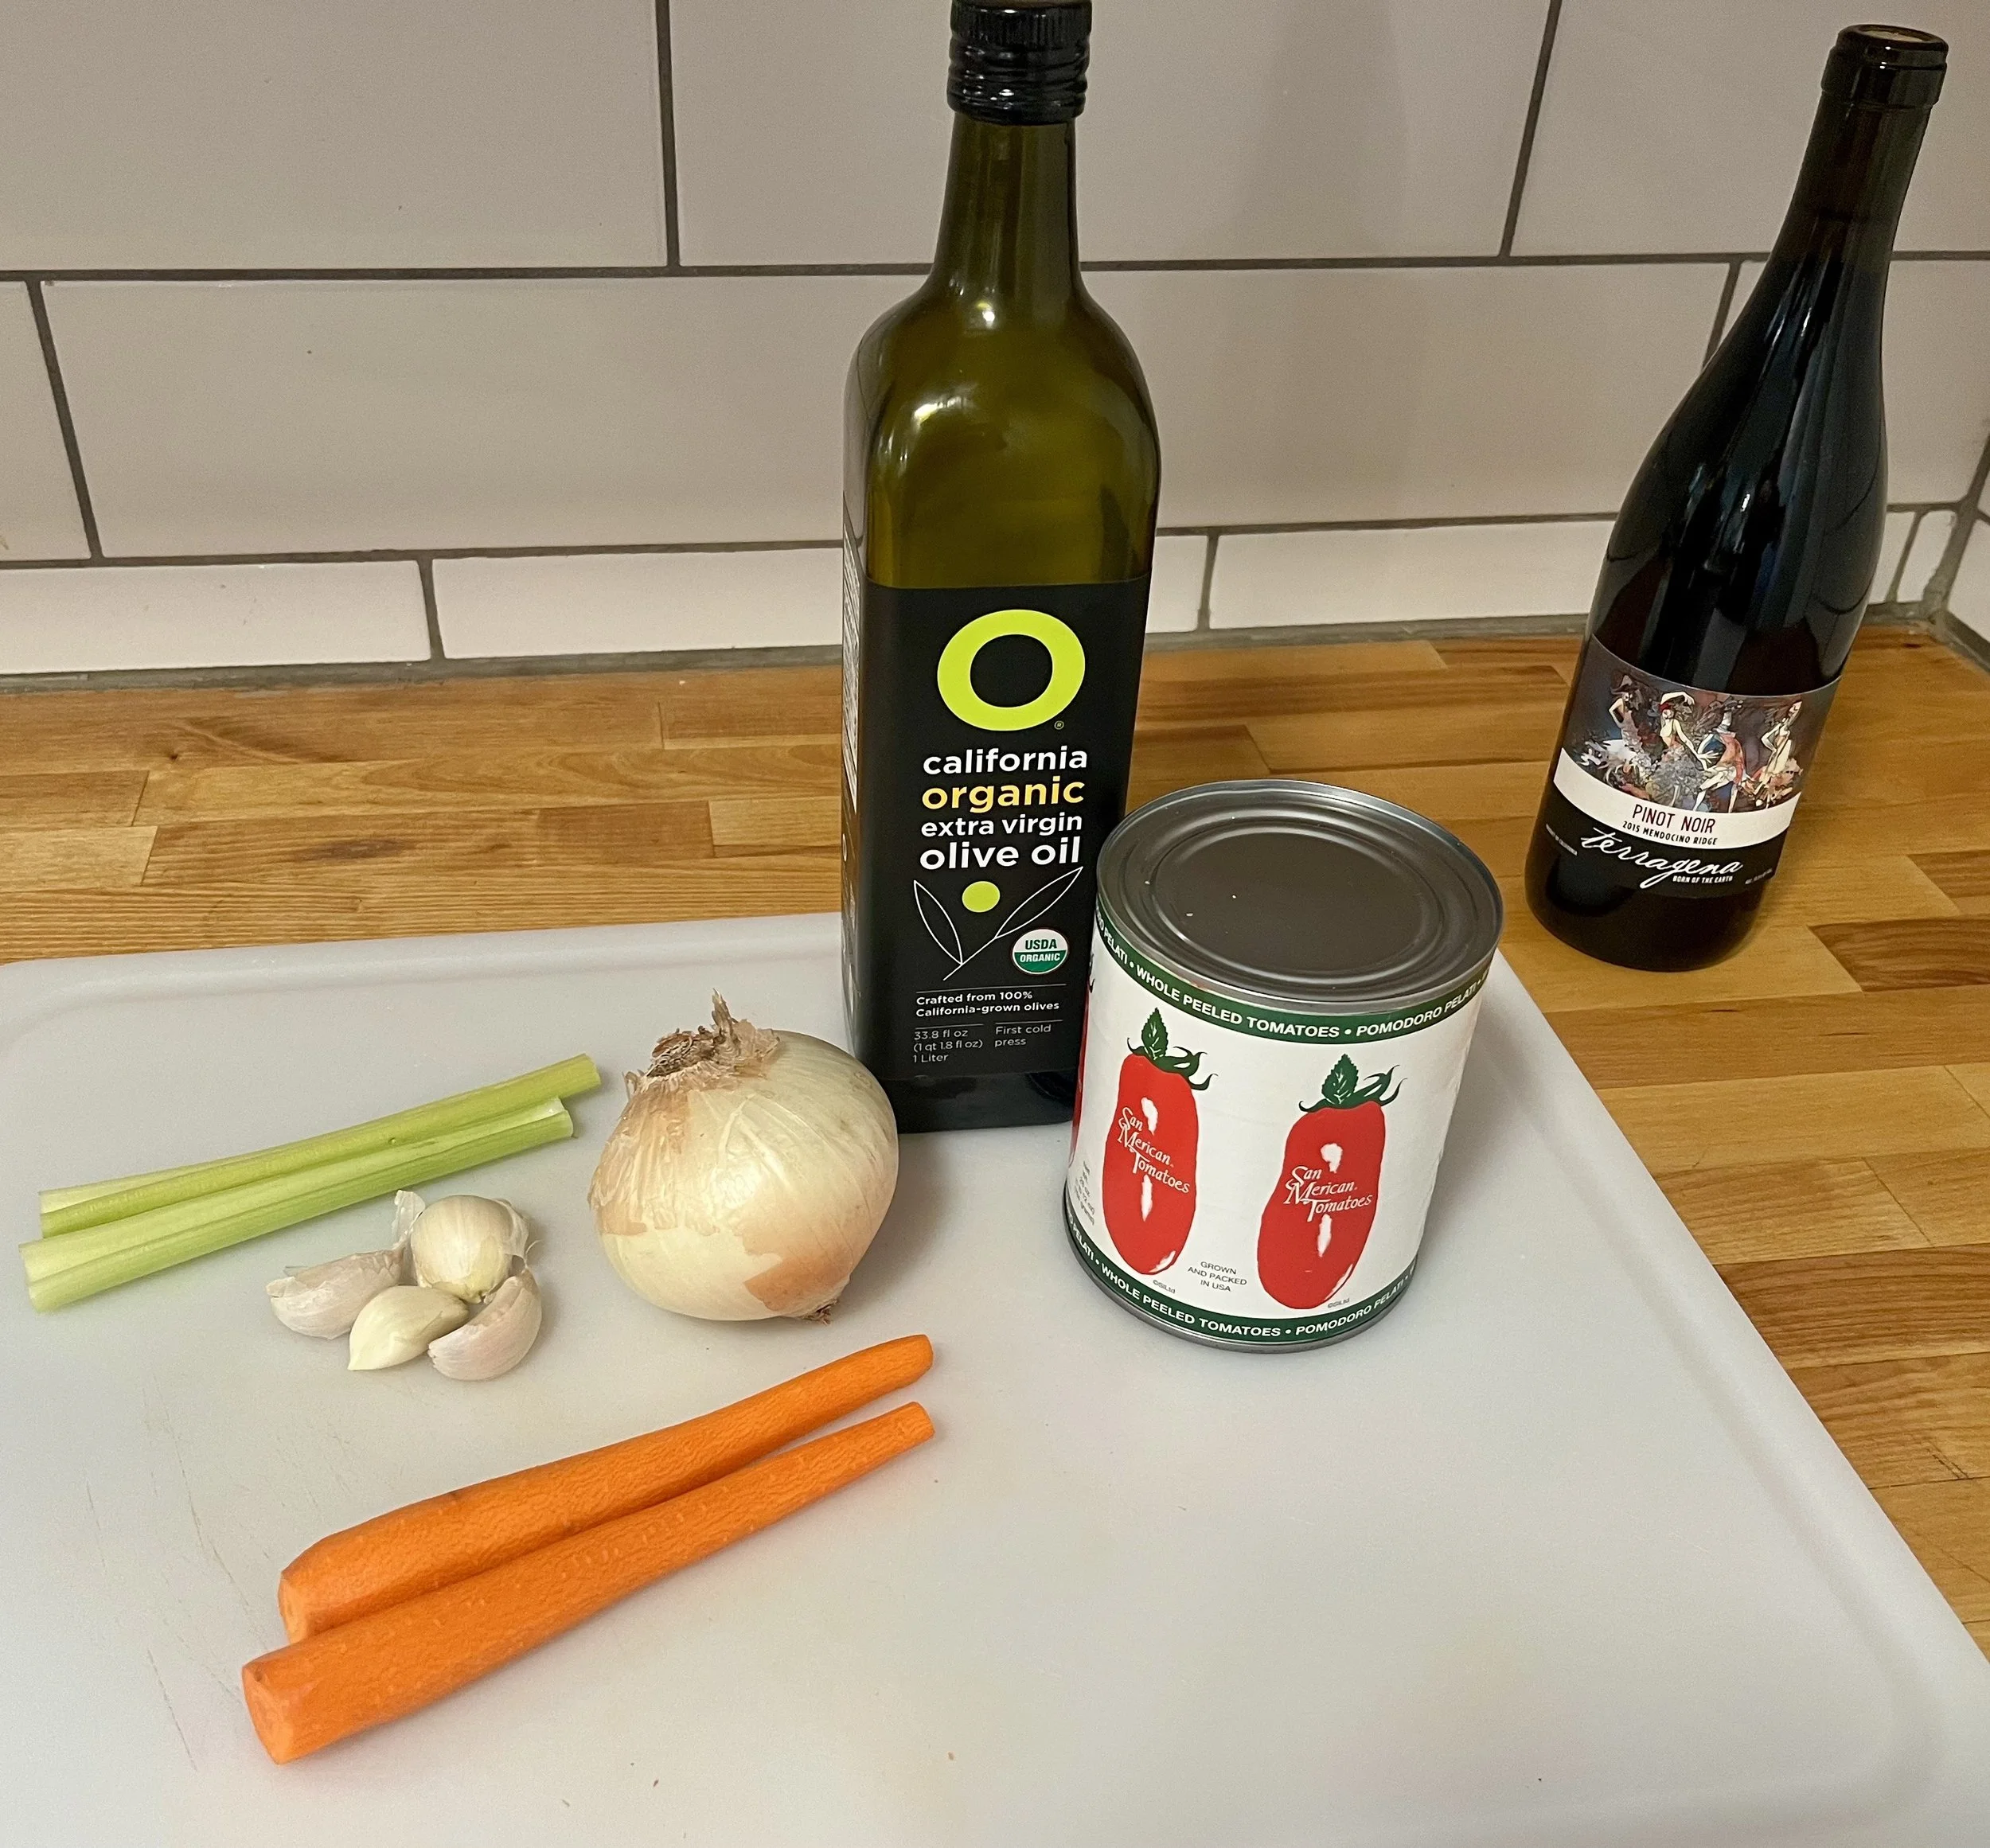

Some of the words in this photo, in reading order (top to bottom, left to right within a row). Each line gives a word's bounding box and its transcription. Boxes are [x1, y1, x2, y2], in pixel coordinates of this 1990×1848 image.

[923, 745, 1087, 775] california
[922, 776, 1085, 813] organic
[921, 818, 994, 837] extra
[1002, 812, 1083, 836] virgin
[1632, 804, 1676, 828] PINOT
[1681, 817, 1716, 834] NOIR
[1622, 821, 1641, 834] 2015
[1642, 827, 1692, 844] MENDOCINO
[1692, 836, 1719, 846] RIDGE
[919, 842, 1020, 870] olive
[1031, 836, 1081, 866] oil
[1024, 939, 1057, 950] USDA
[1020, 953, 1060, 963] ORGANIC
[1103, 926, 1129, 965] PELATI
[1136, 964, 1180, 1002] WHOLE
[1182, 995, 1243, 1026] PEELED
[1246, 1016, 1340, 1039] TOMATOES
[1356, 1007, 1442, 1038] POMODORO
[1444, 981, 1477, 1013] PELATI
[916, 993, 963, 1005] Crafted
[966, 992, 996, 1002] from
[1000, 991, 1032, 1000] 100%
[915, 1003, 1020, 1017] California-grown
[1024, 1002, 1059, 1012] olives
[914, 1030, 939, 1040] 33.8
[942, 1029, 952, 1038] fl
[954, 1029, 969, 1038] oz
[995, 1026, 1021, 1035] First
[1026, 1024, 1052, 1034] cold
[913, 1042, 923, 1053] (1
[924, 1041, 938, 1051] qt
[955, 1039, 964, 1050] fl
[966, 1039, 983, 1050] oz)
[995, 1037, 1026, 1048] press
[913, 1055, 918, 1064] 1
[921, 1053, 949, 1063] Liter
[1118, 1106, 1144, 1131] San
[1129, 1146, 1190, 1195] Tomatoes
[1286, 1165, 1322, 1190] San
[1302, 1194, 1372, 1222] Tomatoes
[1188, 1266, 1208, 1277] AND
[1209, 1273, 1247, 1285] PACKED
[1200, 1261, 1237, 1275] GROWN
[1212, 1282, 1231, 1292] USA
[1100, 1263, 1141, 1302] WHOLE
[1142, 1295, 1196, 1325] PEELED
[1199, 1316, 1282, 1338] TOMATOES
[1296, 1305, 1372, 1335] POMODORO
[1374, 1279, 1404, 1309] PELATI
